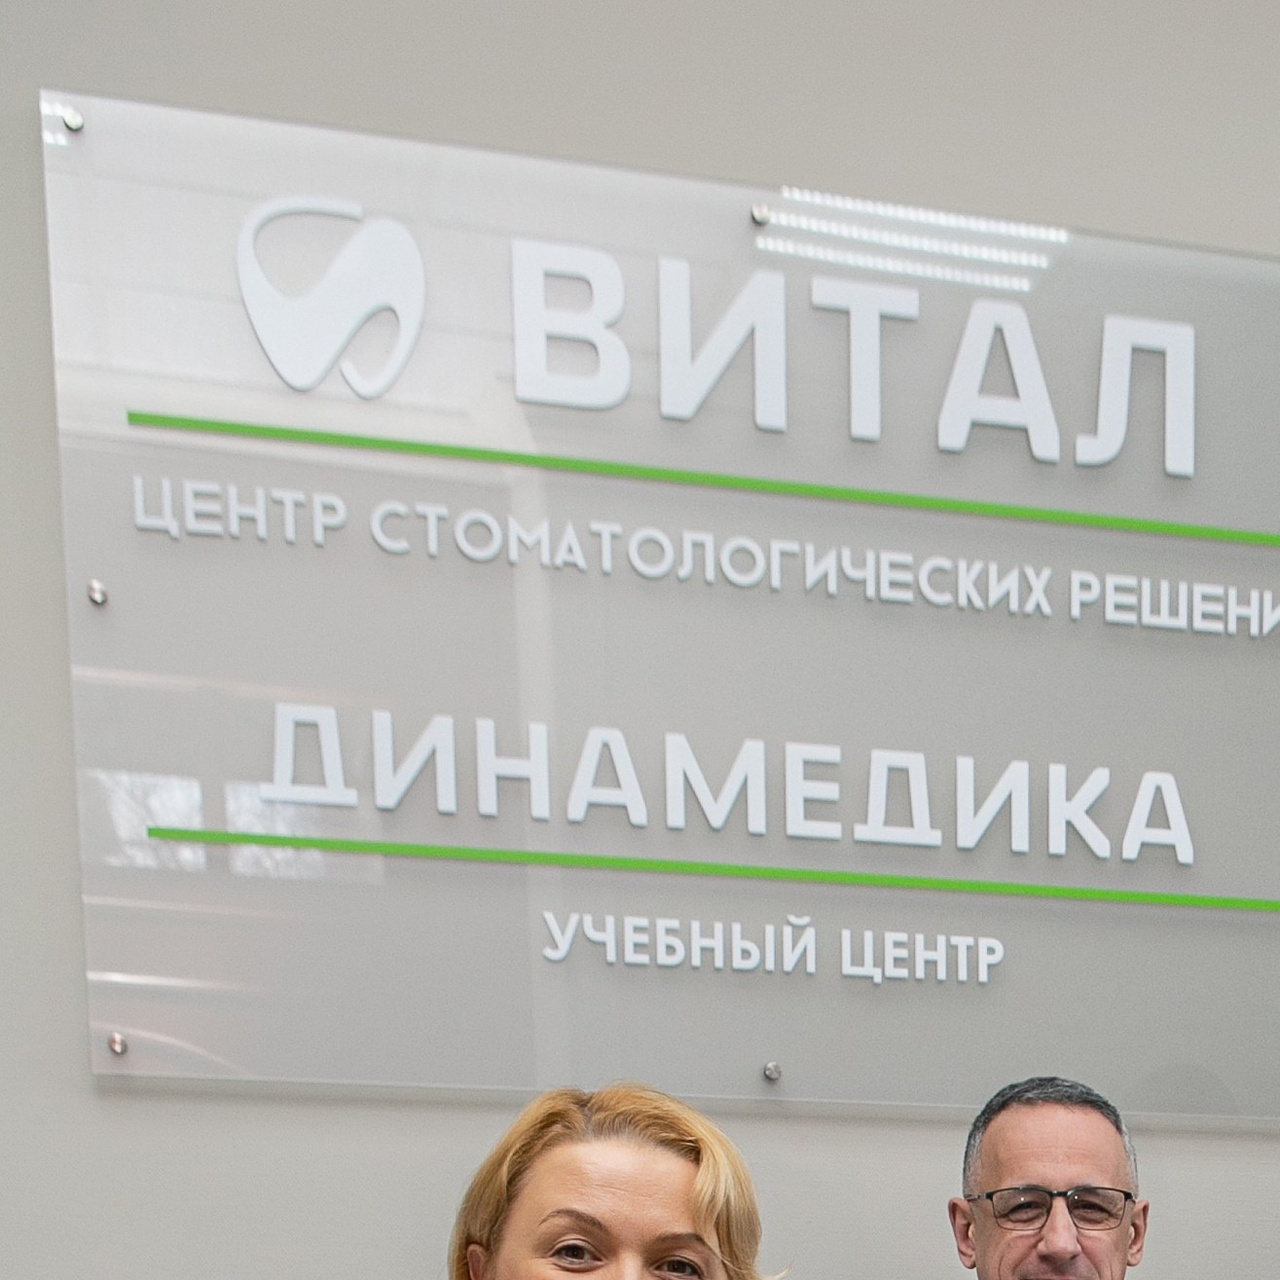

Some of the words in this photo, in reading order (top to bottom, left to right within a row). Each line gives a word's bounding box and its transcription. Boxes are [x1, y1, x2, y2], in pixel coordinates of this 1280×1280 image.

[509, 237, 1196, 479] ВИТАЛ
[132, 474, 348, 546] ЦЕНТР
[371, 499, 1054, 620] СТОМАТОЛОГИЧЕСКИХ
[259, 701, 1196, 864] ДИНАМЕДИКА
[541, 909, 818, 977] УЧЕБНЫЙ
[840, 928, 1006, 984] ЦЕНТР
